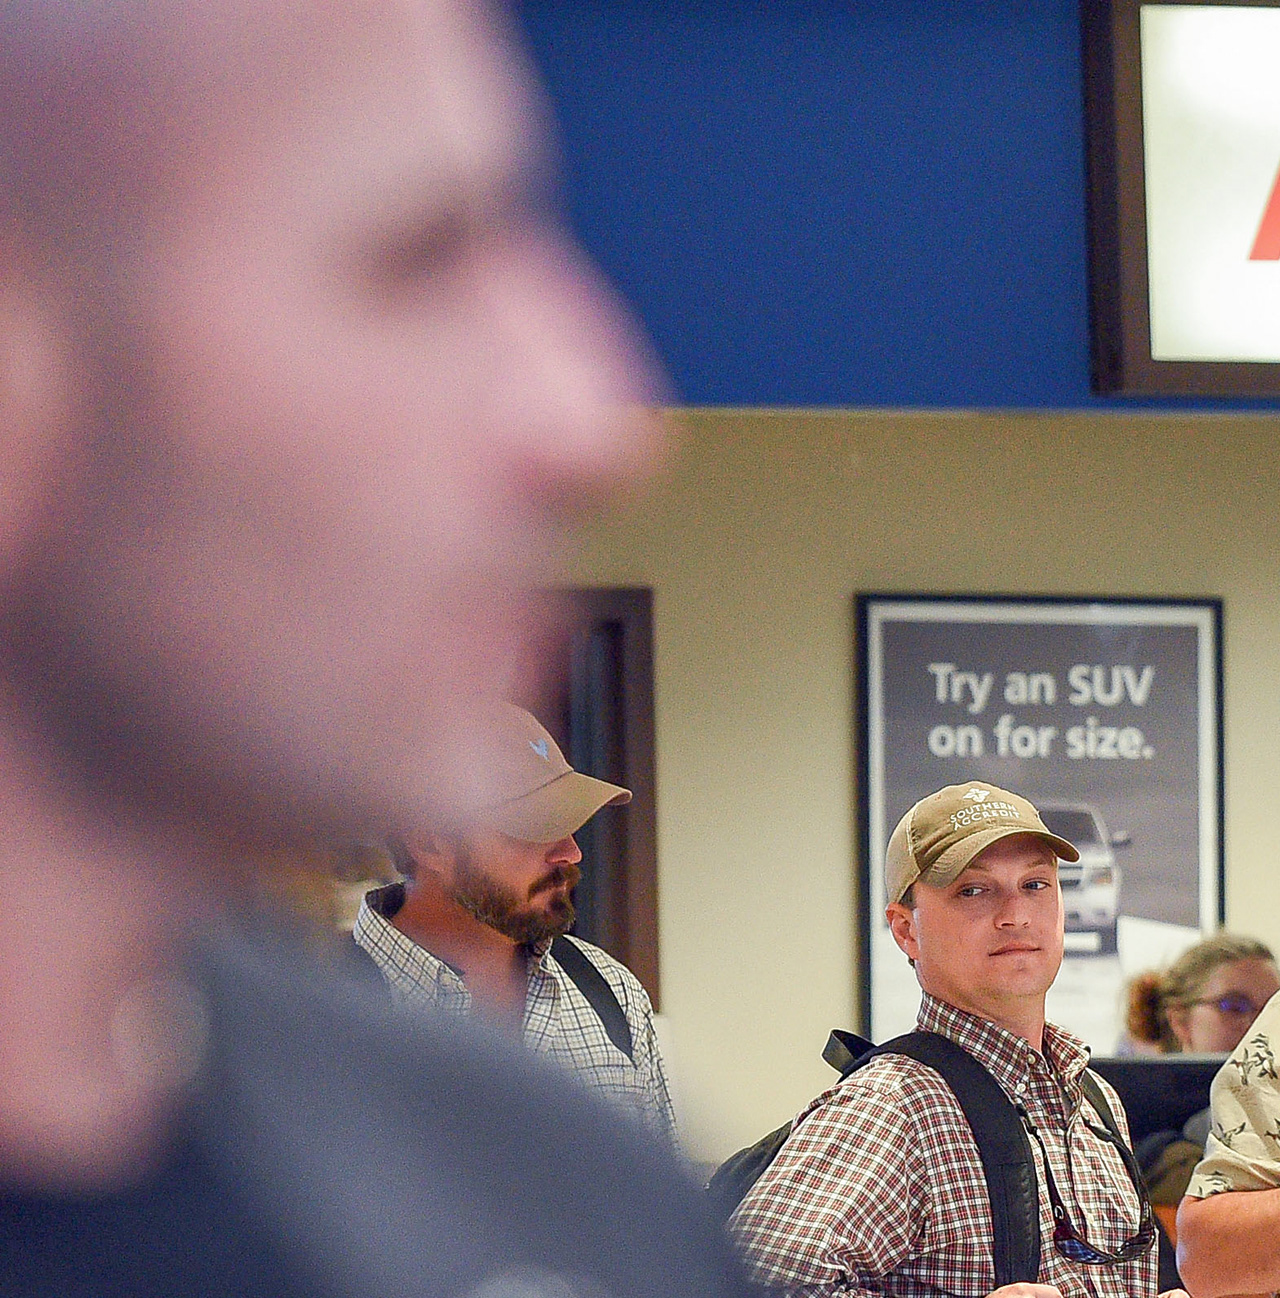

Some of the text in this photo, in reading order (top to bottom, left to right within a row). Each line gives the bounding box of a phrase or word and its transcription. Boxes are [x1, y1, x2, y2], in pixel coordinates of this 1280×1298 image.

[928, 662, 1156, 714] Try an SUV
[927, 713, 1156, 760] on for size.
[950, 801, 1017, 823] SOUTHERN
[954, 809, 1020, 831] AGCREDIT
